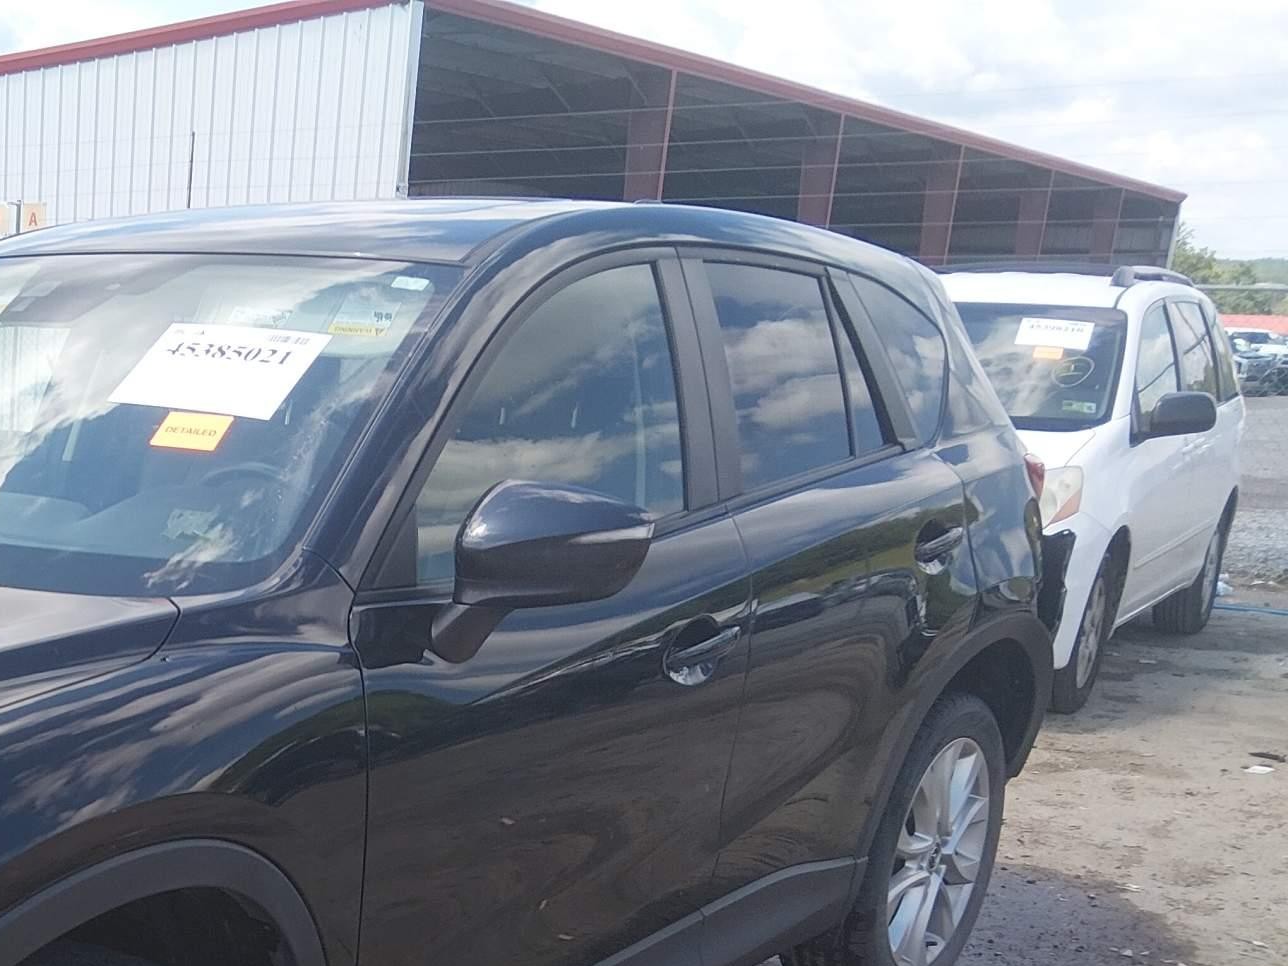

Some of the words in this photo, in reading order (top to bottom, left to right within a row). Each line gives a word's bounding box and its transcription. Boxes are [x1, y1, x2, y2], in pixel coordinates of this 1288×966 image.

[28, 211, 38, 226] A
[166, 341, 293, 366] 45385021
[164, 425, 217, 438] DETAILED
